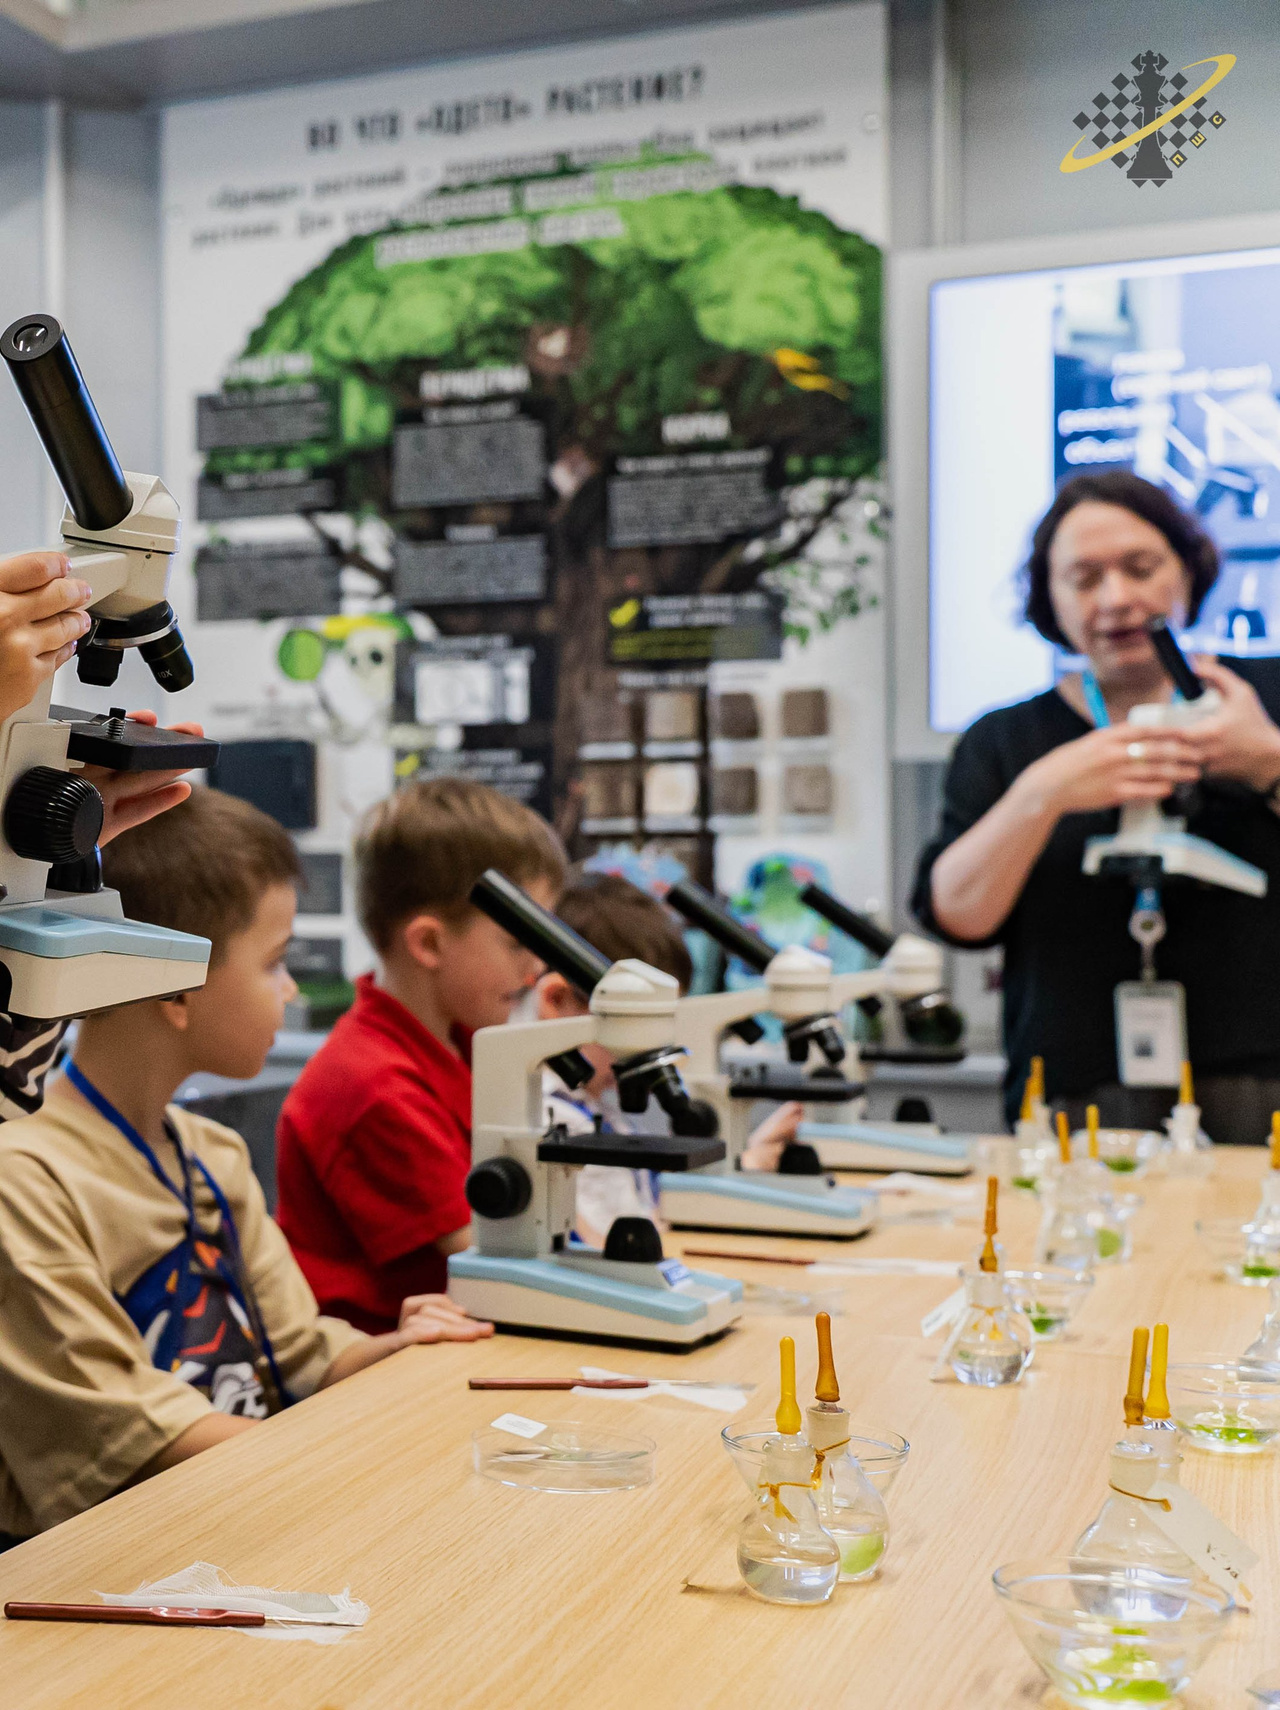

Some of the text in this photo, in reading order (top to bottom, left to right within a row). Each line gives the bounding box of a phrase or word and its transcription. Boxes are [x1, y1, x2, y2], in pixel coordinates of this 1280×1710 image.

[307, 119, 339, 150] ВО
[354, 110, 400, 141] ЧТО
[546, 64, 706, 114] РАСТЕНИЕ?
